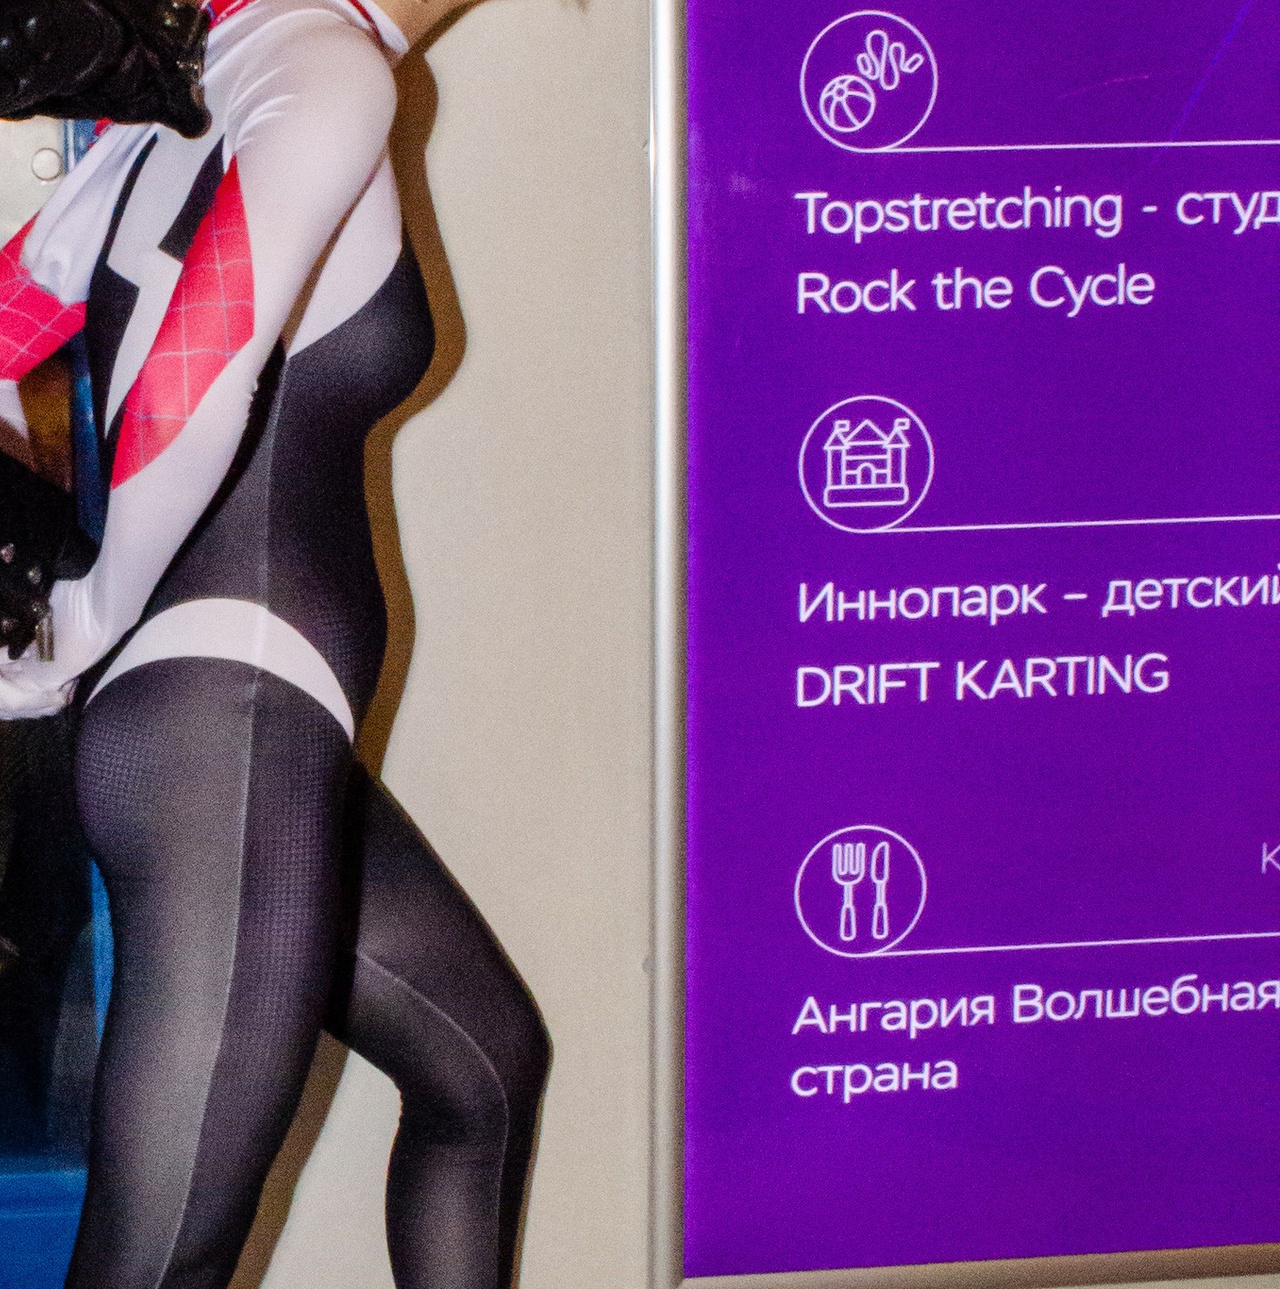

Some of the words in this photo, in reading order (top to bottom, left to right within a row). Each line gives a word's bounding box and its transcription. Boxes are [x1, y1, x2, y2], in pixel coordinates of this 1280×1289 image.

[794, 185, 1122, 244] Topstretching
[797, 268, 916, 314] Rock
[931, 267, 1013, 311] the
[1029, 263, 1155, 318] Cycle
[799, 581, 1047, 626] Иннопарк
[796, 661, 940, 708] DRIFT
[955, 652, 1169, 701] KARTING
[791, 995, 995, 1039] Ангария
[1012, 973, 1280, 1024] Волшебная
[790, 1060, 958, 1104] страна
